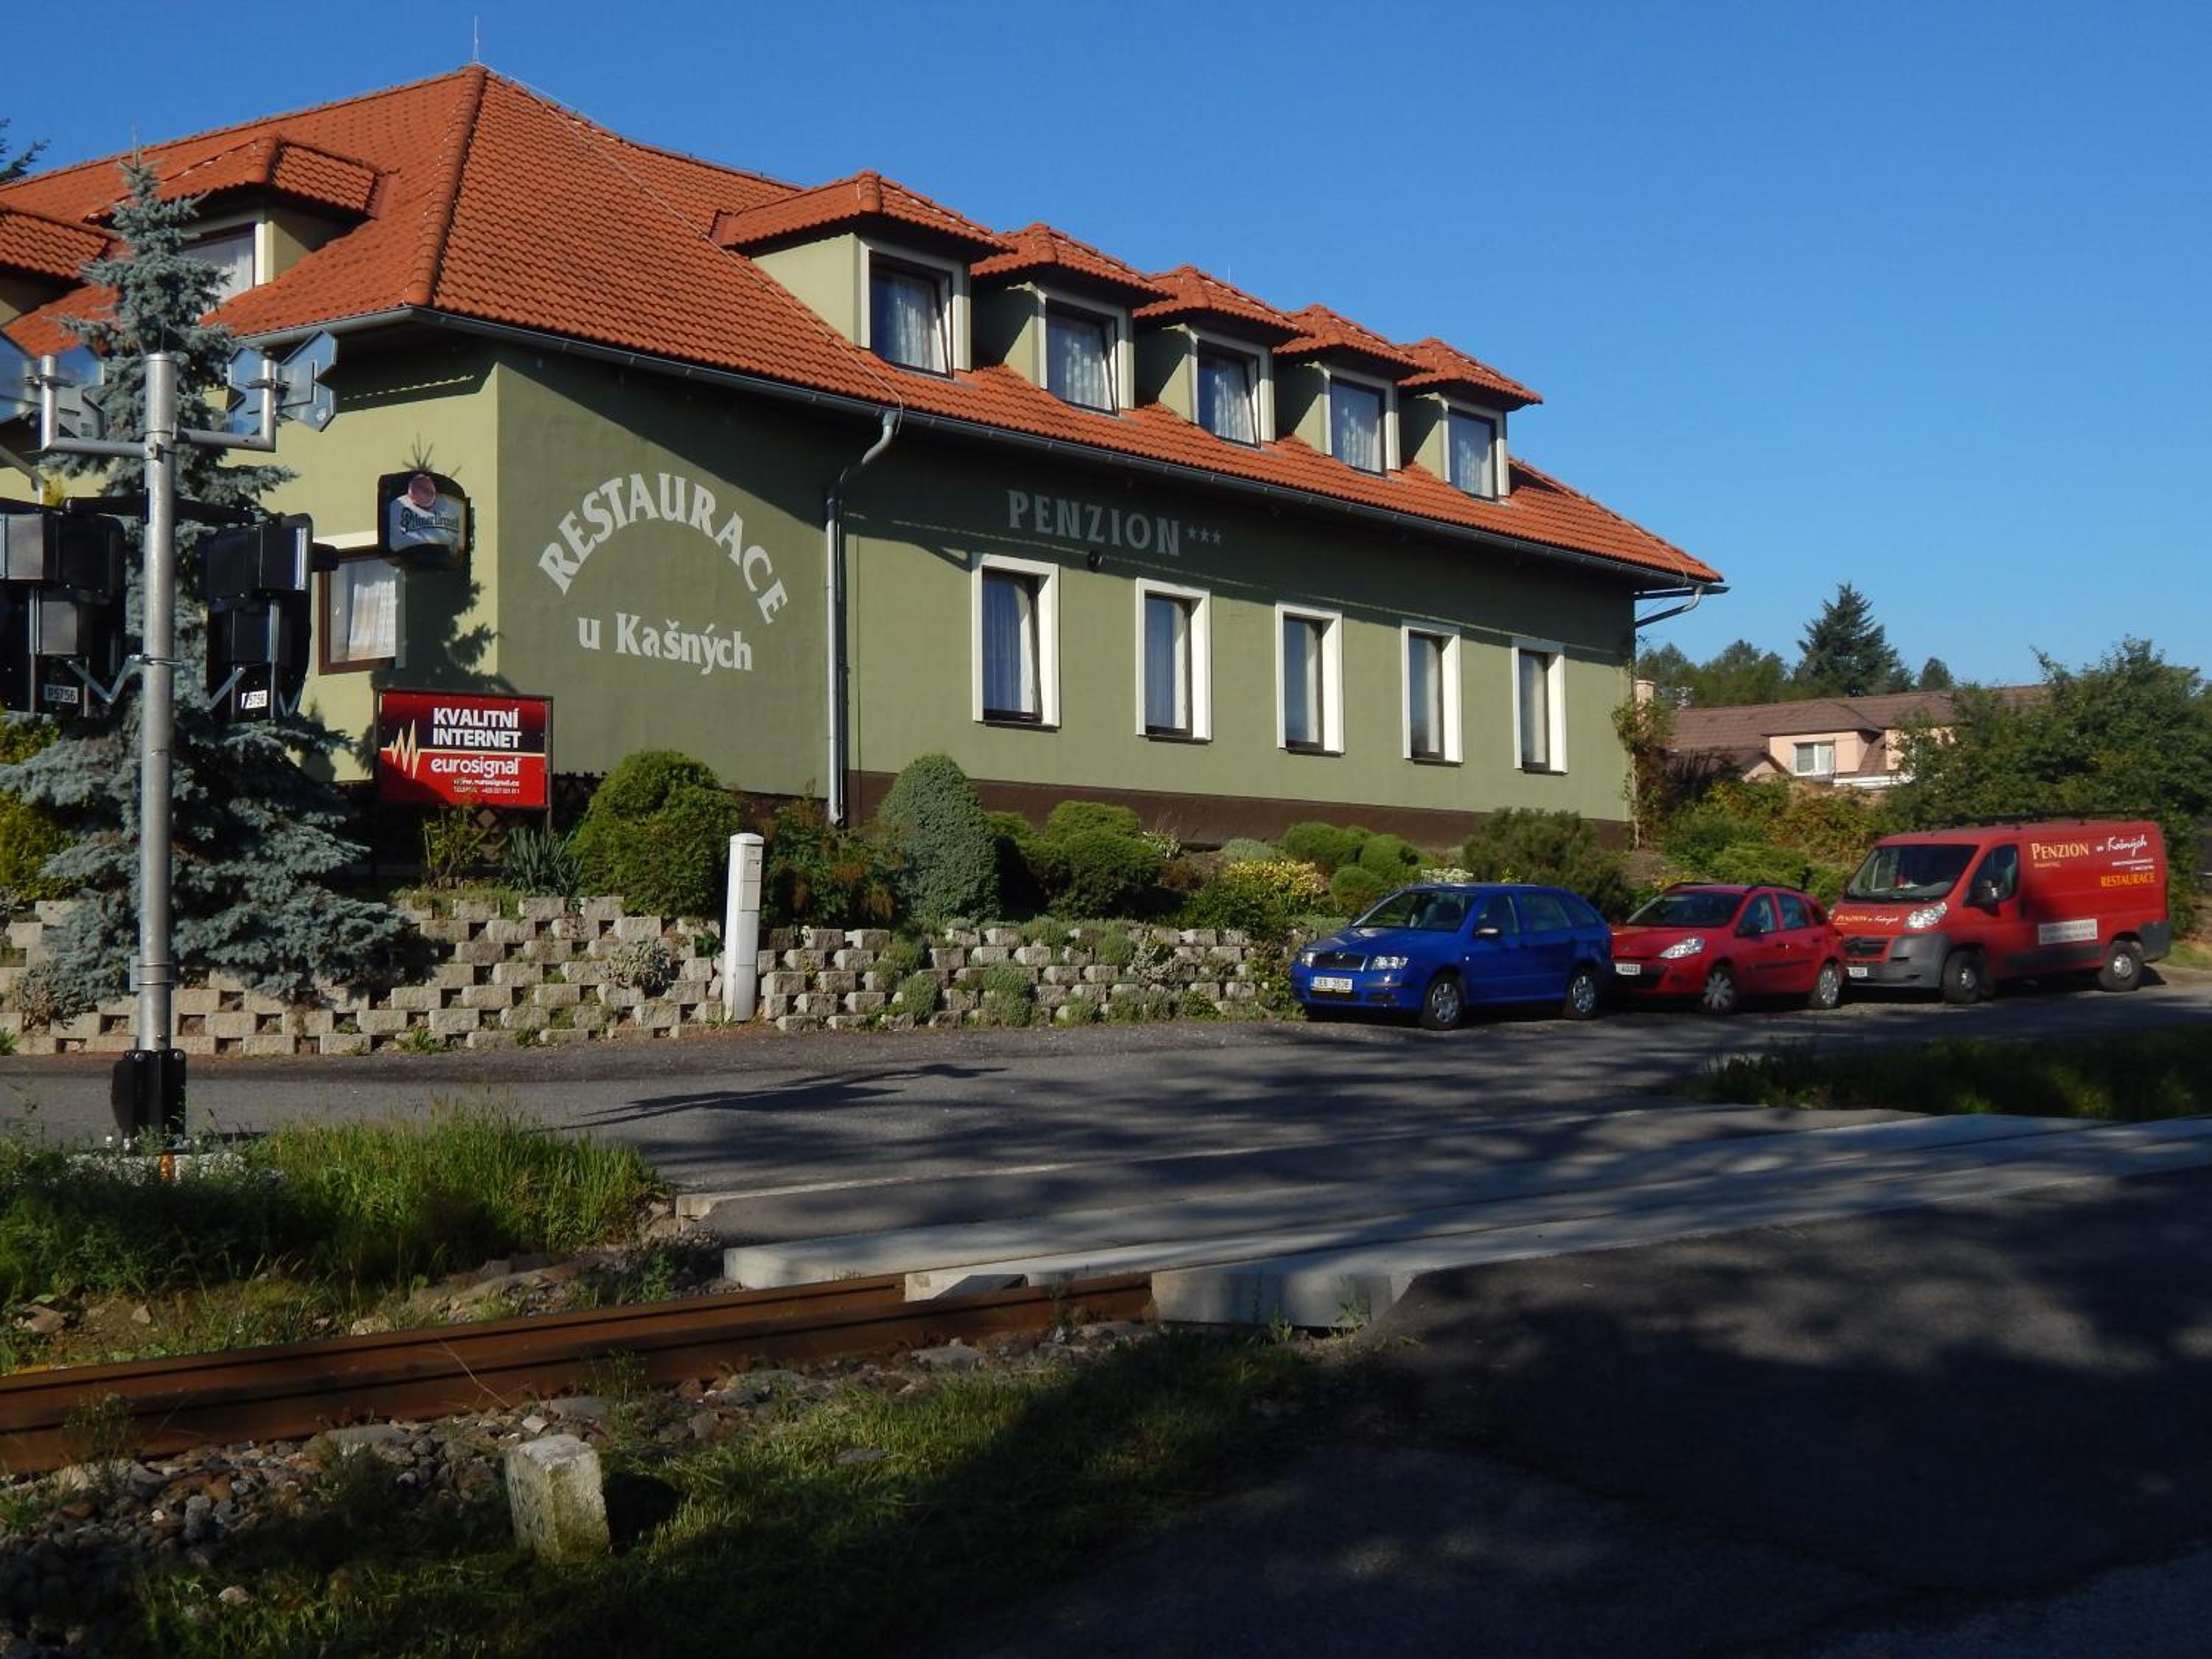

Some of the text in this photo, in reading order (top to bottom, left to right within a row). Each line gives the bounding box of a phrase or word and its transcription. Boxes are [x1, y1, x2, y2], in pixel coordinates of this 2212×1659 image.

[1007, 490, 1180, 556] PENZION
[538, 473, 788, 625] RESTAURACE
[578, 612, 752, 675] u Kašných
[433, 707, 519, 728] KVALITNÍ
[433, 728, 521, 748] INTERNET
[431, 757, 519, 778] eurosignal
[2031, 842, 2089, 860] PENZION
[2101, 872, 2154, 887] RESTAURACE
